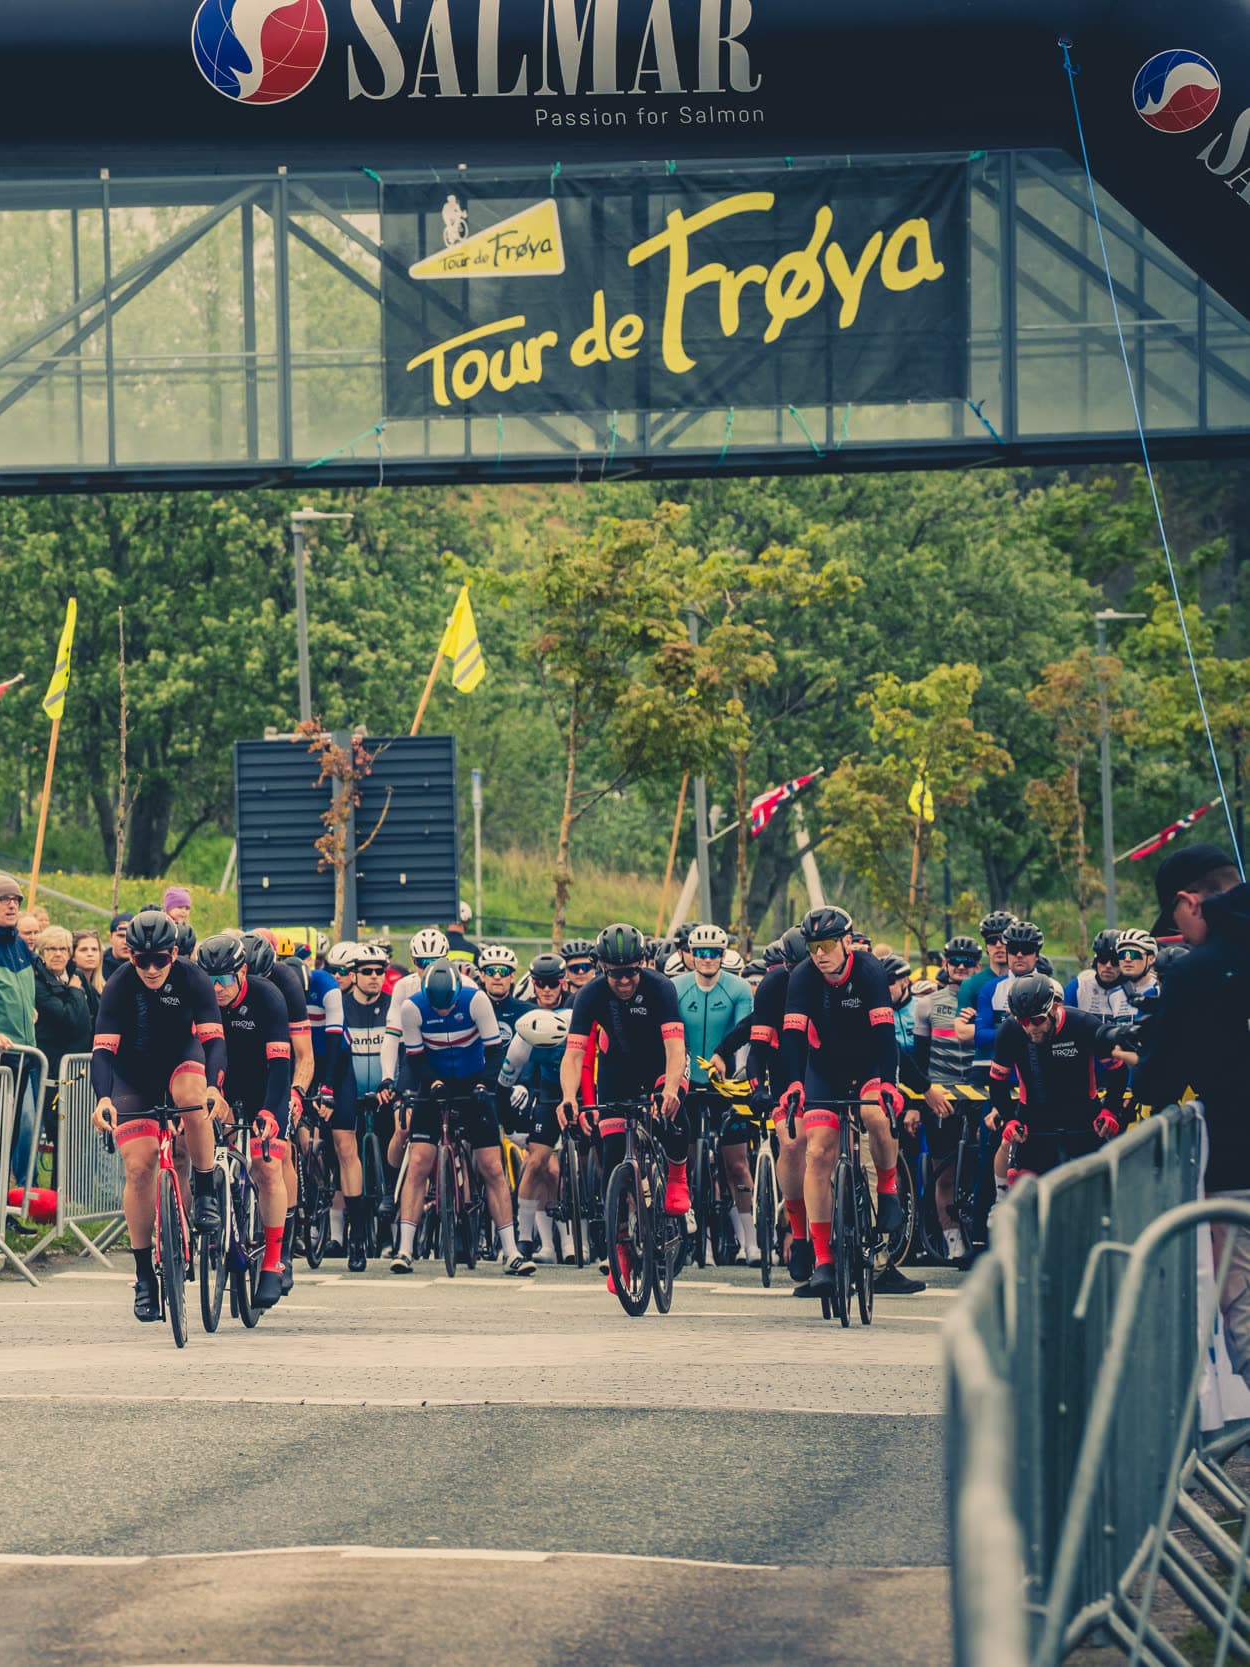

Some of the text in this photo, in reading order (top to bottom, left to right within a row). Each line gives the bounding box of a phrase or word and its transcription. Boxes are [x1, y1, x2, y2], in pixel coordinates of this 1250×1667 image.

[535, 105, 765, 127] Passion for Salmon
[438, 230, 553, 271] Tour de Frøya
[407, 191, 944, 406] Tour de Frøya
